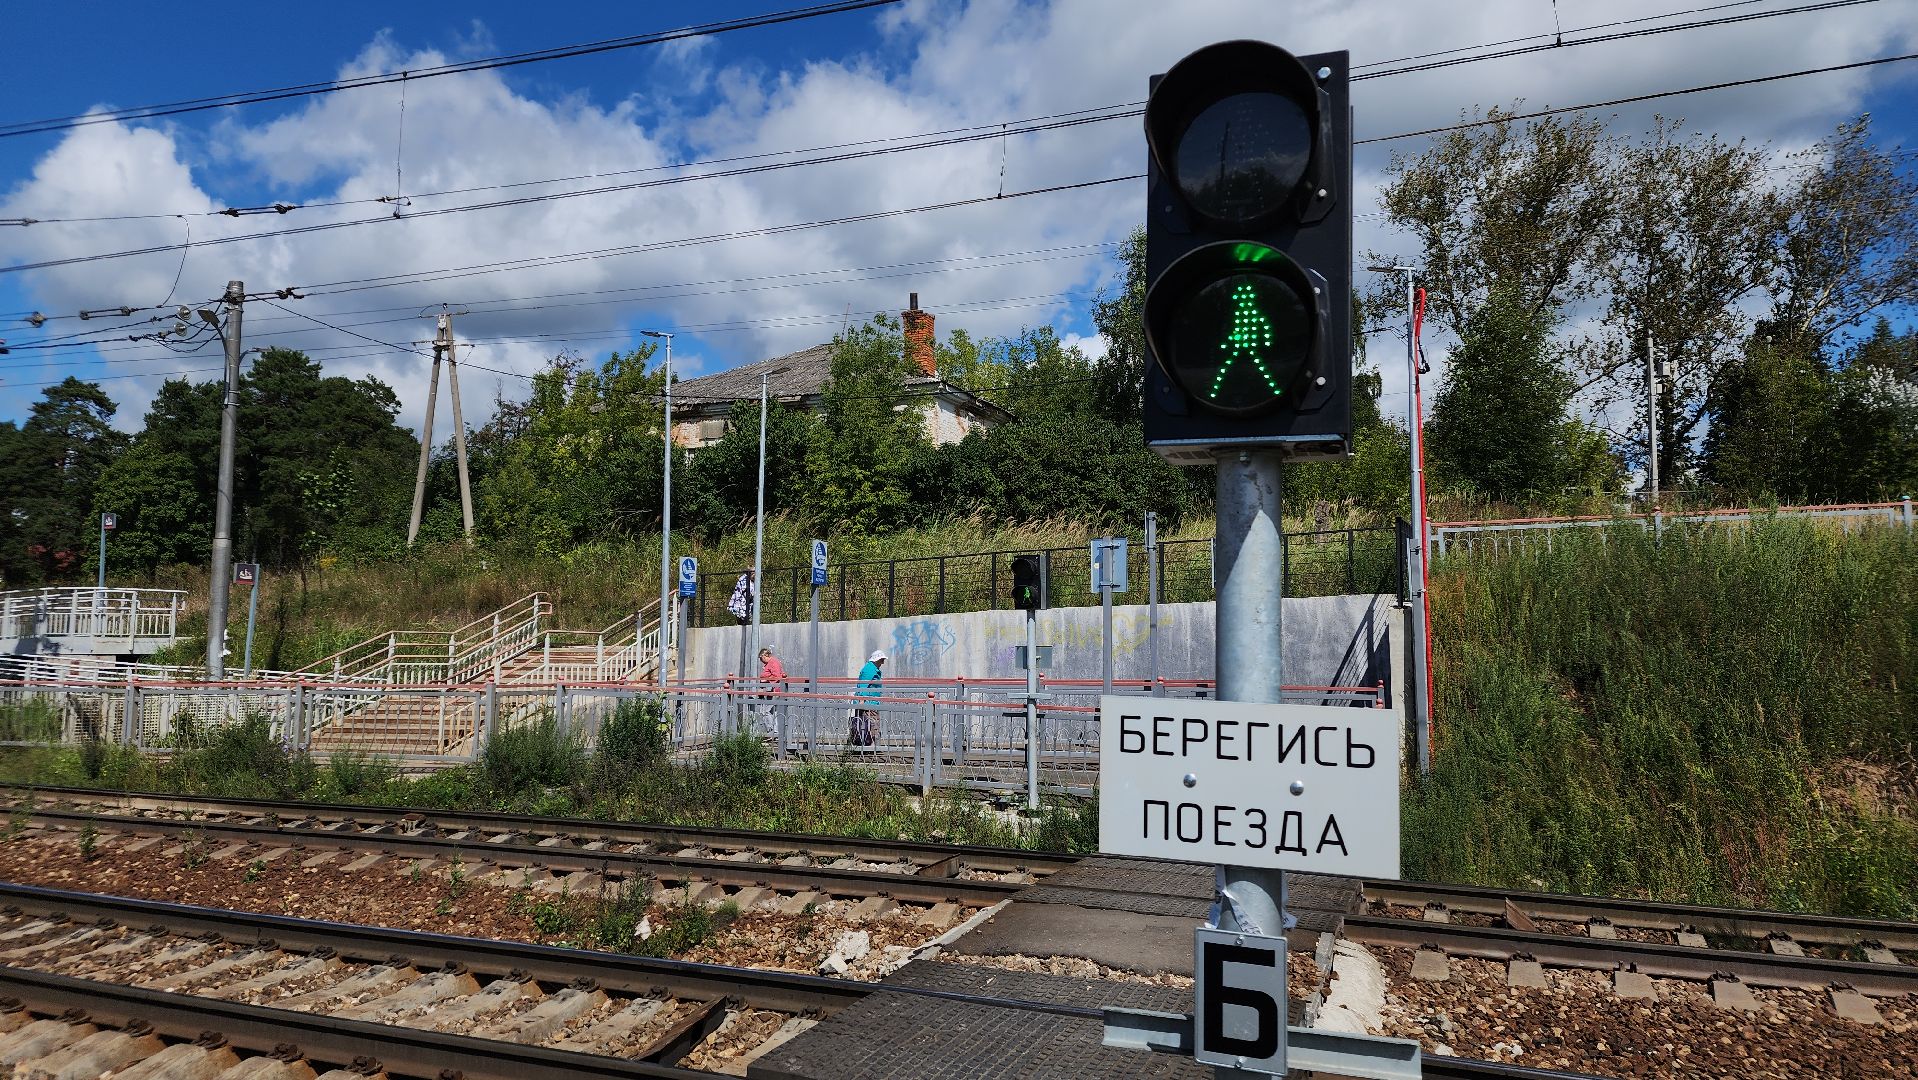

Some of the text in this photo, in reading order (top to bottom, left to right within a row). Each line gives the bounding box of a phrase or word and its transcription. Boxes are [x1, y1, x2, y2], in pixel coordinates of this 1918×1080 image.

[1120, 715, 1375, 768] БЕРЕГИСЬ
[1143, 800, 1348, 856] ПОЕЗДА
[1203, 941, 1278, 1059] Б
